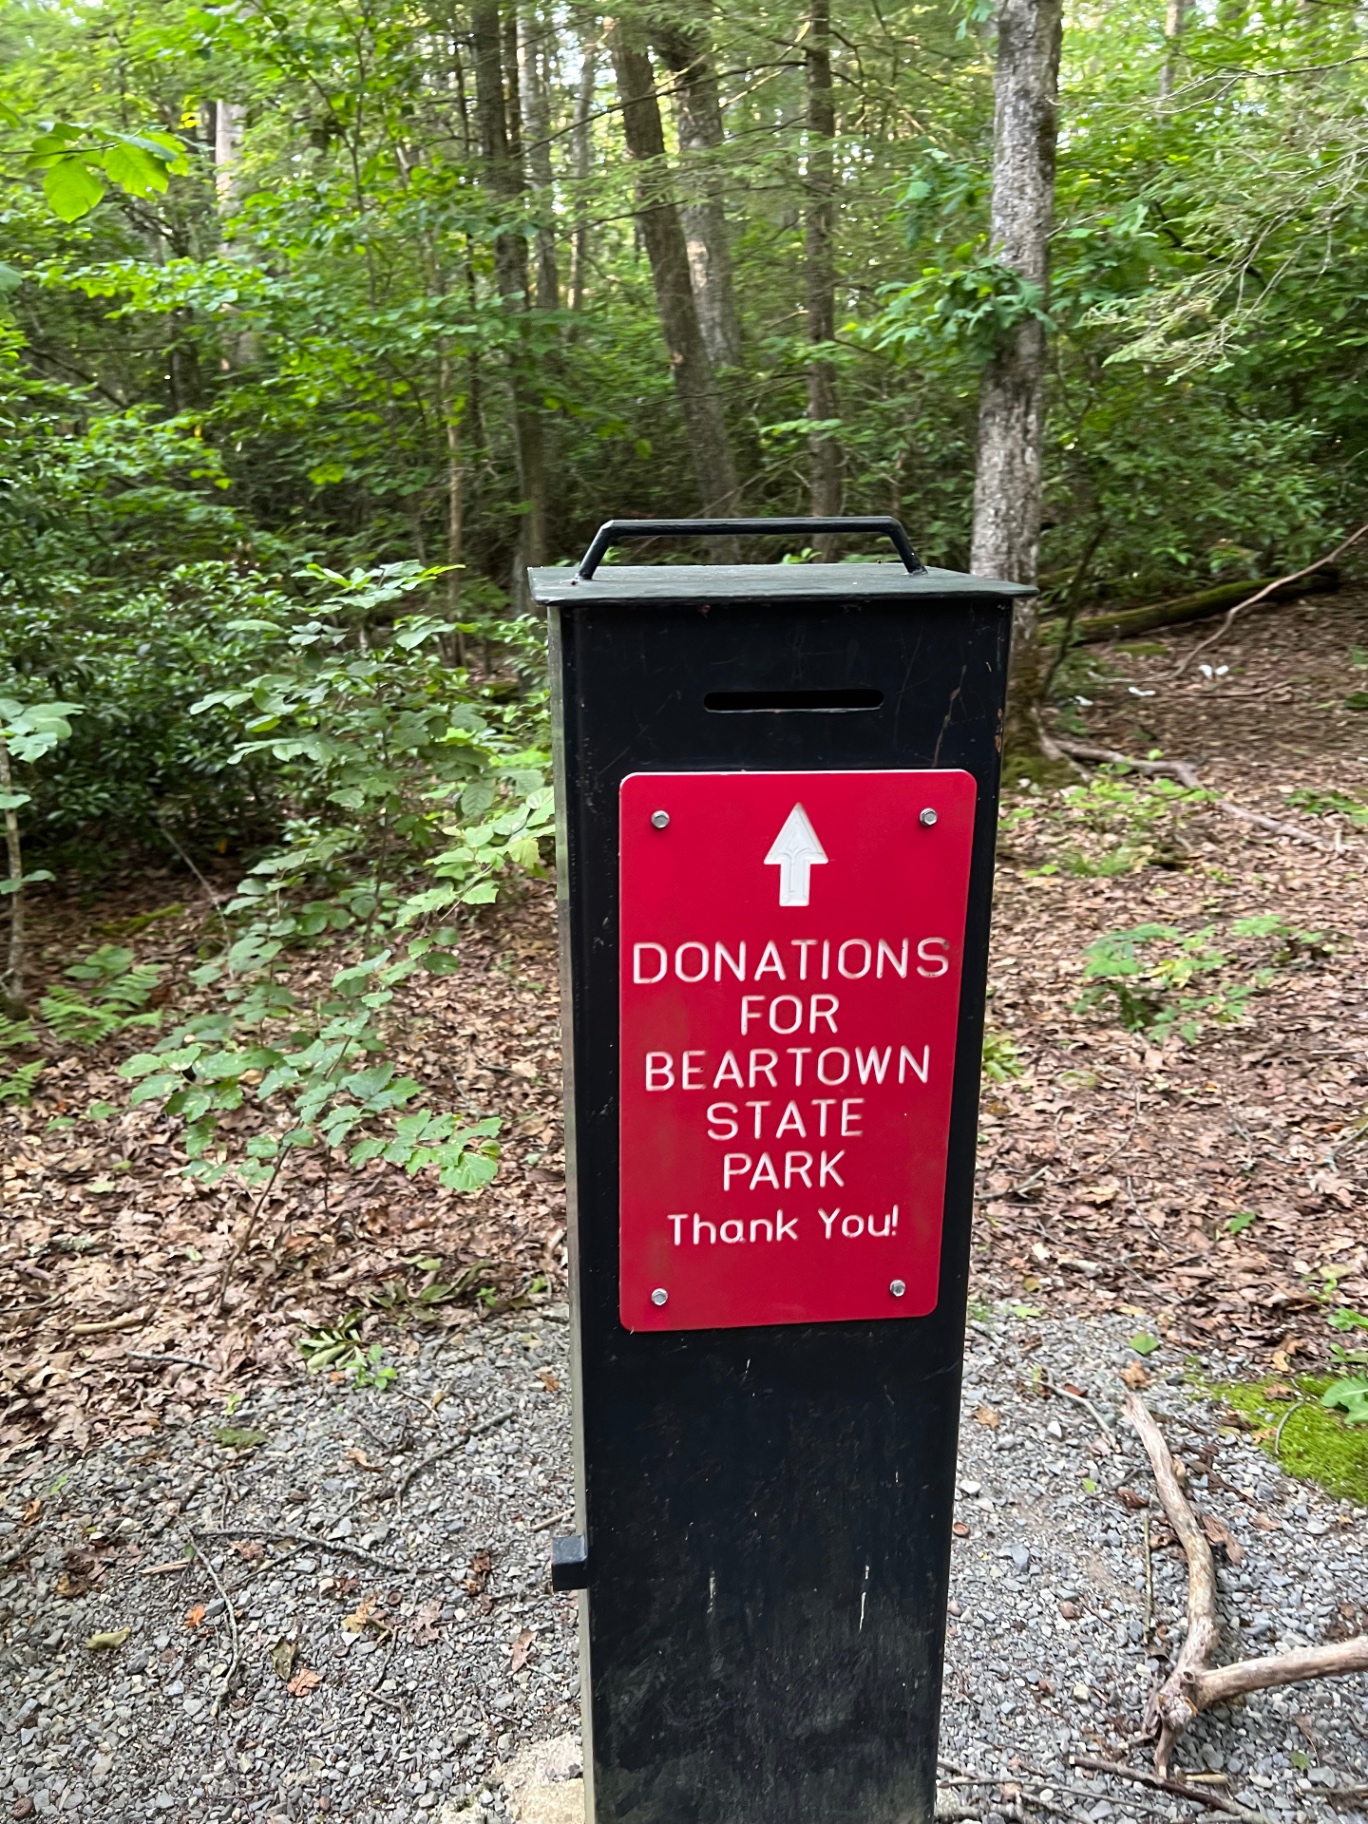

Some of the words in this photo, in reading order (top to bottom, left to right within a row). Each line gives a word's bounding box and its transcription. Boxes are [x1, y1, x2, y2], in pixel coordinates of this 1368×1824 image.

[632, 937, 950, 985] DONATIONS
[740, 993, 841, 1036] FOR
[645, 1045, 931, 1092] BEARTOWN
[706, 1098, 865, 1141] STATE
[723, 1150, 846, 1192] PARK
[667, 1209, 799, 1246] Thank
[817, 1204, 900, 1240] You!
